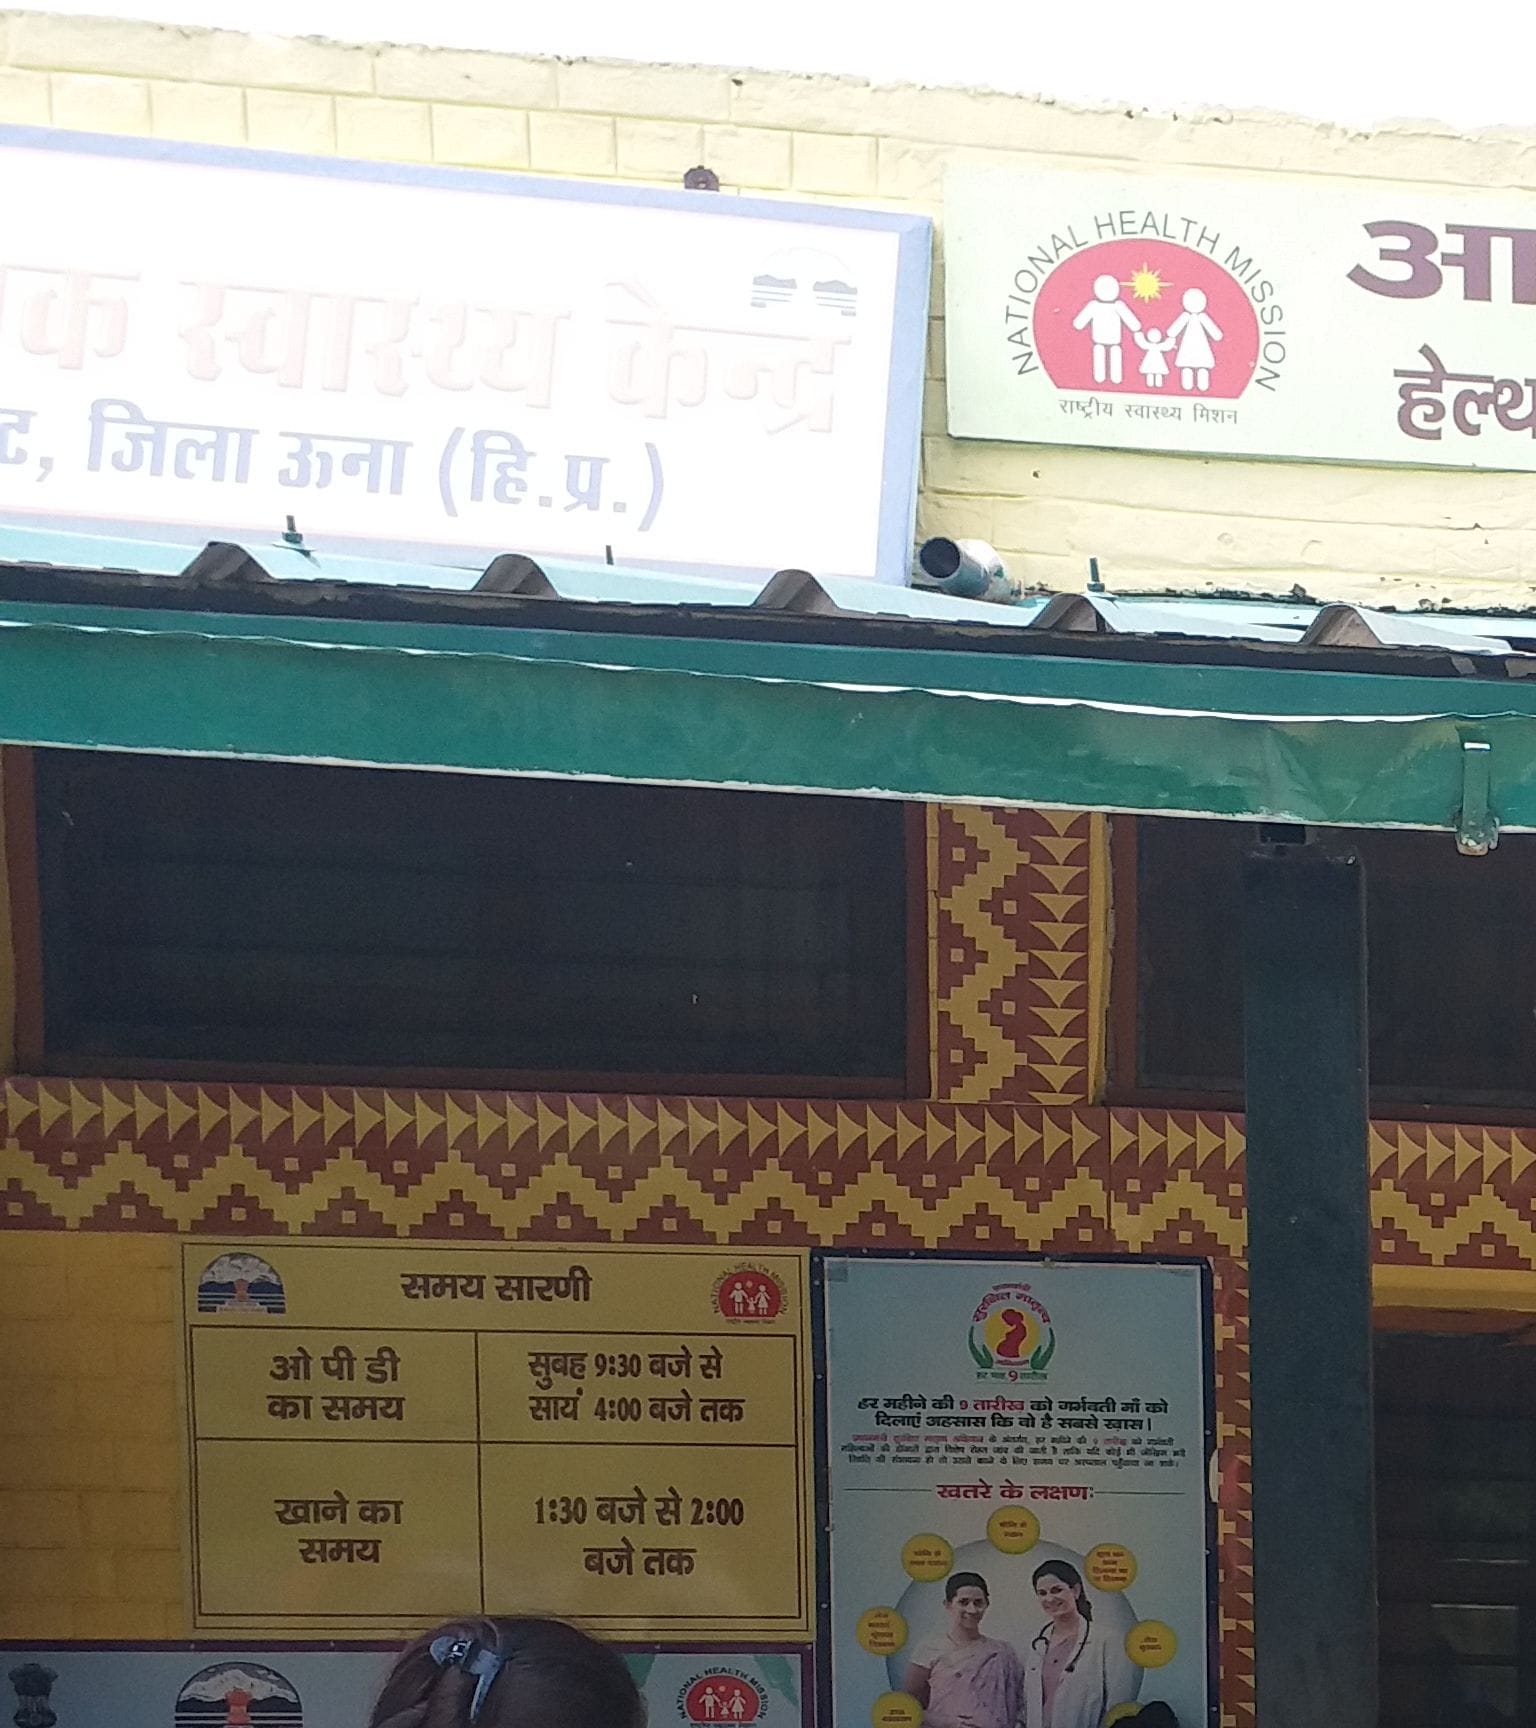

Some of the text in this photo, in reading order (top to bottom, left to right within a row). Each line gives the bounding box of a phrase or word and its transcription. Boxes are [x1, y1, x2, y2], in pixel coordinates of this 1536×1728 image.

[1005, 210, 1286, 392] NATIONAL HEALTH MISSION
[0, 262, 853, 434] क स्वास्थ्य केन्द्र
[1058, 396, 1238, 424] राष्ट्रीय स्वास्थ्य मिशन
[88, 398, 259, 484] जिला
[278, 430, 413, 496] ऊना
[439, 426, 664, 532] (हि.प्र.)
[401, 1265, 591, 1302] समय सारणी
[269, 1346, 399, 1385] ओ पी डी
[529, 1345, 722, 1390] सुबह 9:30 बजे से
[1008, 1370, 1018, 1381] 9
[267, 1395, 404, 1422] का समय
[529, 1386, 745, 1423] सायं 4:00 बजे तक
[857, 1398, 879, 1410] हर
[883, 1394, 927, 1410] महीने
[932, 1394, 954, 1410] की
[960, 1400, 968, 1410] 9
[1030, 1396, 1053, 1411] को
[1058, 1397, 1116, 1412] गर्भवती
[1145, 1398, 1168, 1413] को
[875, 1411, 921, 1428] दिलाएं
[926, 1416, 986, 1427] अहसास
[991, 1413, 1013, 1427] कि
[1018, 1413, 1036, 1428] वो
[1041, 1413, 1053, 1429] है
[1057, 1414, 1099, 1429] सबसे
[535, 1486, 744, 1527] 1:30 बजे से 2:00
[937, 1478, 991, 1499] खतरे
[1000, 1479, 1023, 1499] के
[274, 1490, 403, 1525] खाने का
[299, 1538, 381, 1565] समय
[584, 1537, 697, 1577] बजे तक
[676, 1667, 768, 1719] NATIONAL HEALTH MISSION
